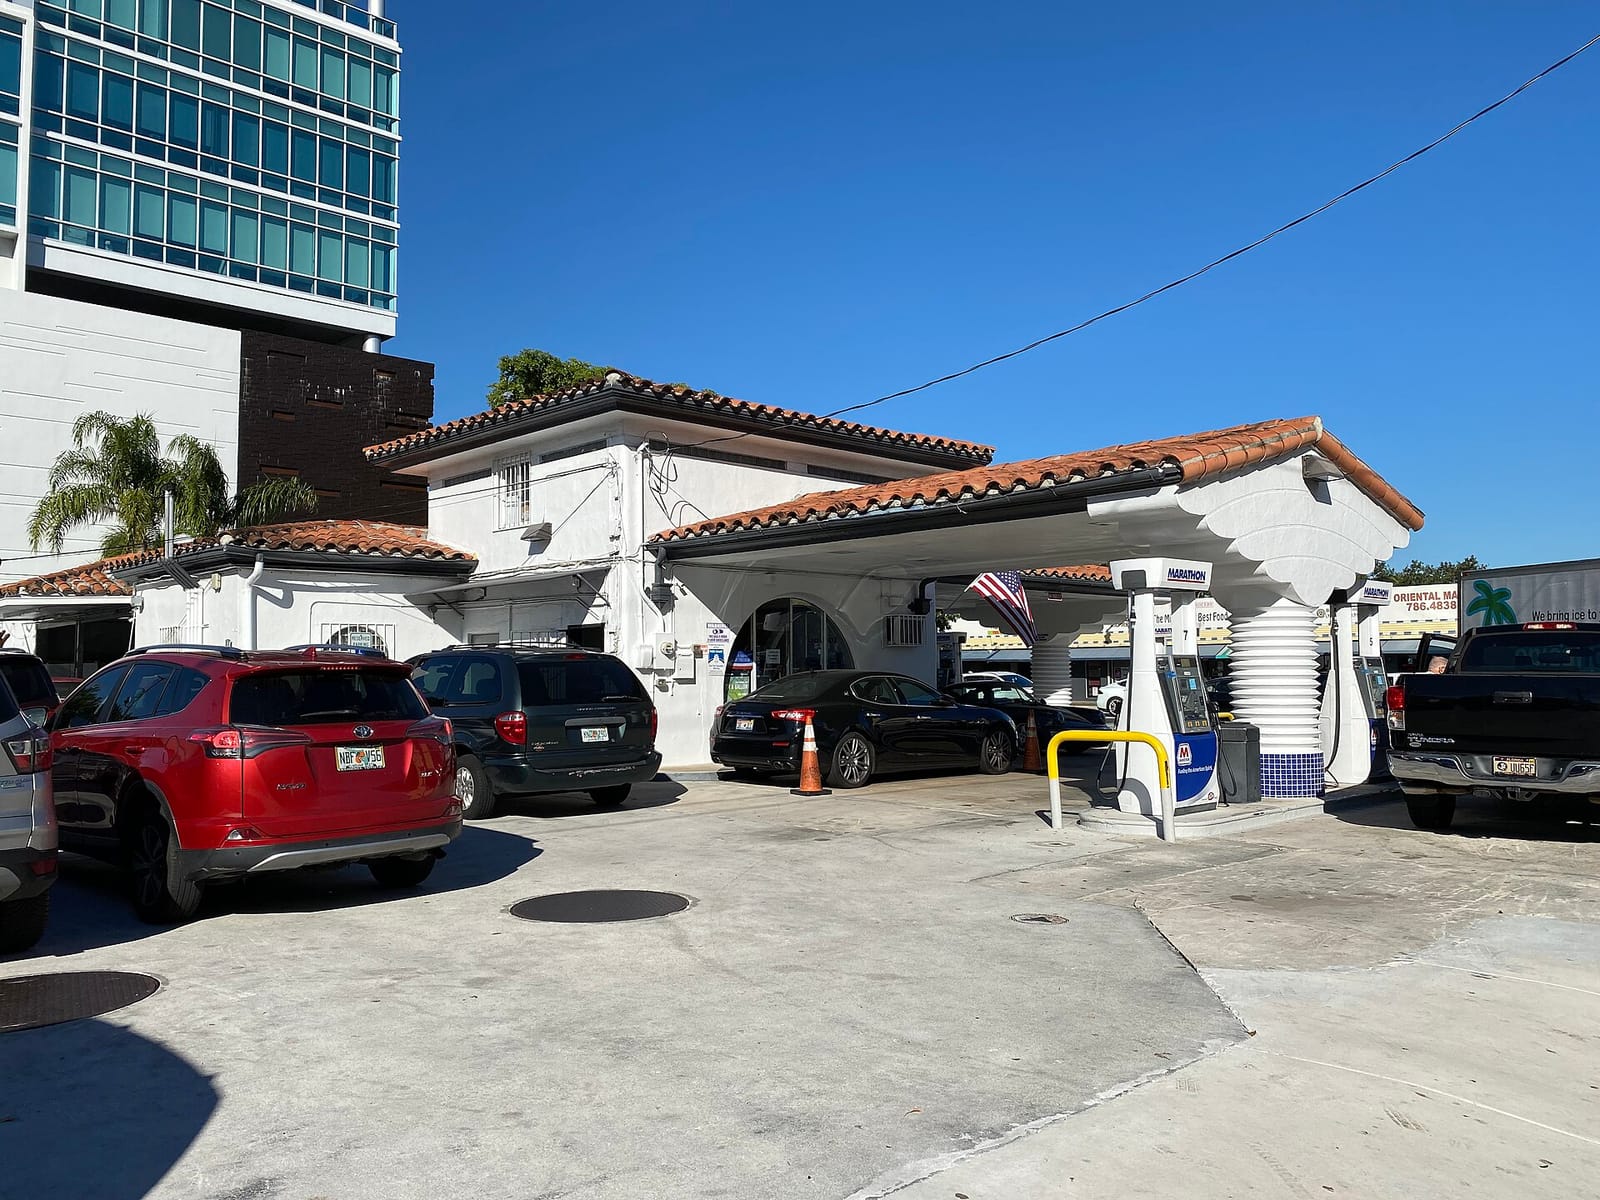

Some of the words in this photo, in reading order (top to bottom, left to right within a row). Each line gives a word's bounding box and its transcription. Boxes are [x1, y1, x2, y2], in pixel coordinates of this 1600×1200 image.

[1167, 568, 1206, 580] MARATHON
[1363, 586, 1389, 598] MARATHON
[1393, 591, 1441, 603] ORIENTAL
[1406, 600, 1457, 612] 786.4838
[1197, 612, 1212, 622] Best
[1532, 611, 1545, 621] We
[1547, 610, 1569, 622] bring
[1572, 610, 1585, 620] ice
[1588, 609, 1597, 619] to
[1183, 630, 1188, 640] 7
[1369, 637, 1374, 646] 5
[1407, 736, 1455, 744] TUNDRA
[339, 751, 354, 764] NBF
[1180, 747, 1189, 757] M
